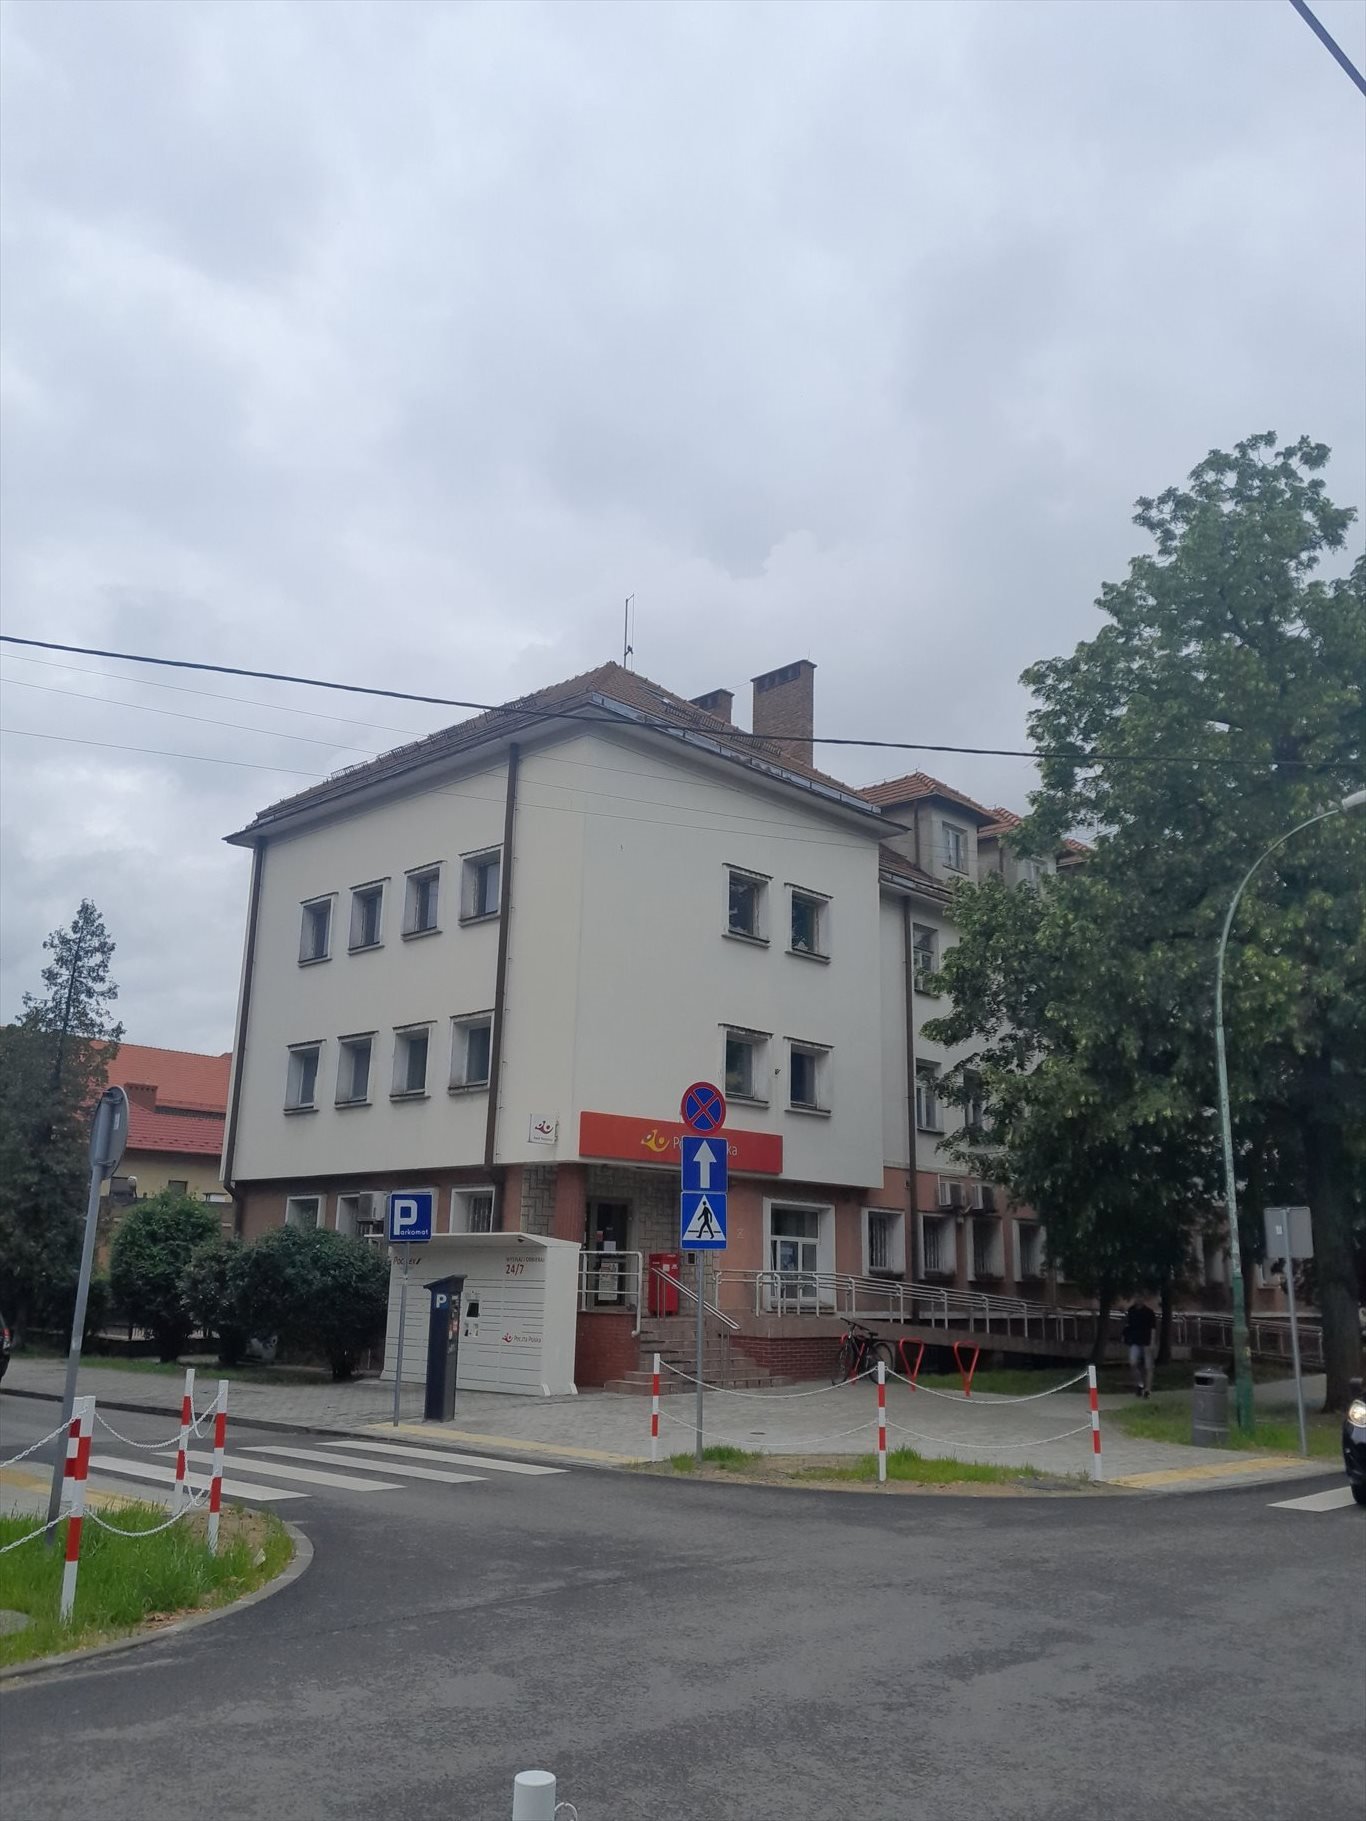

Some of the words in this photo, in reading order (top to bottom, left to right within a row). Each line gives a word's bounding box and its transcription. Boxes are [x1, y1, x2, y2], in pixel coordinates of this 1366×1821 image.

[393, 1199, 429, 1236] Parkomat
[506, 1264, 524, 1276] 24/7
[436, 1294, 447, 1308] P
